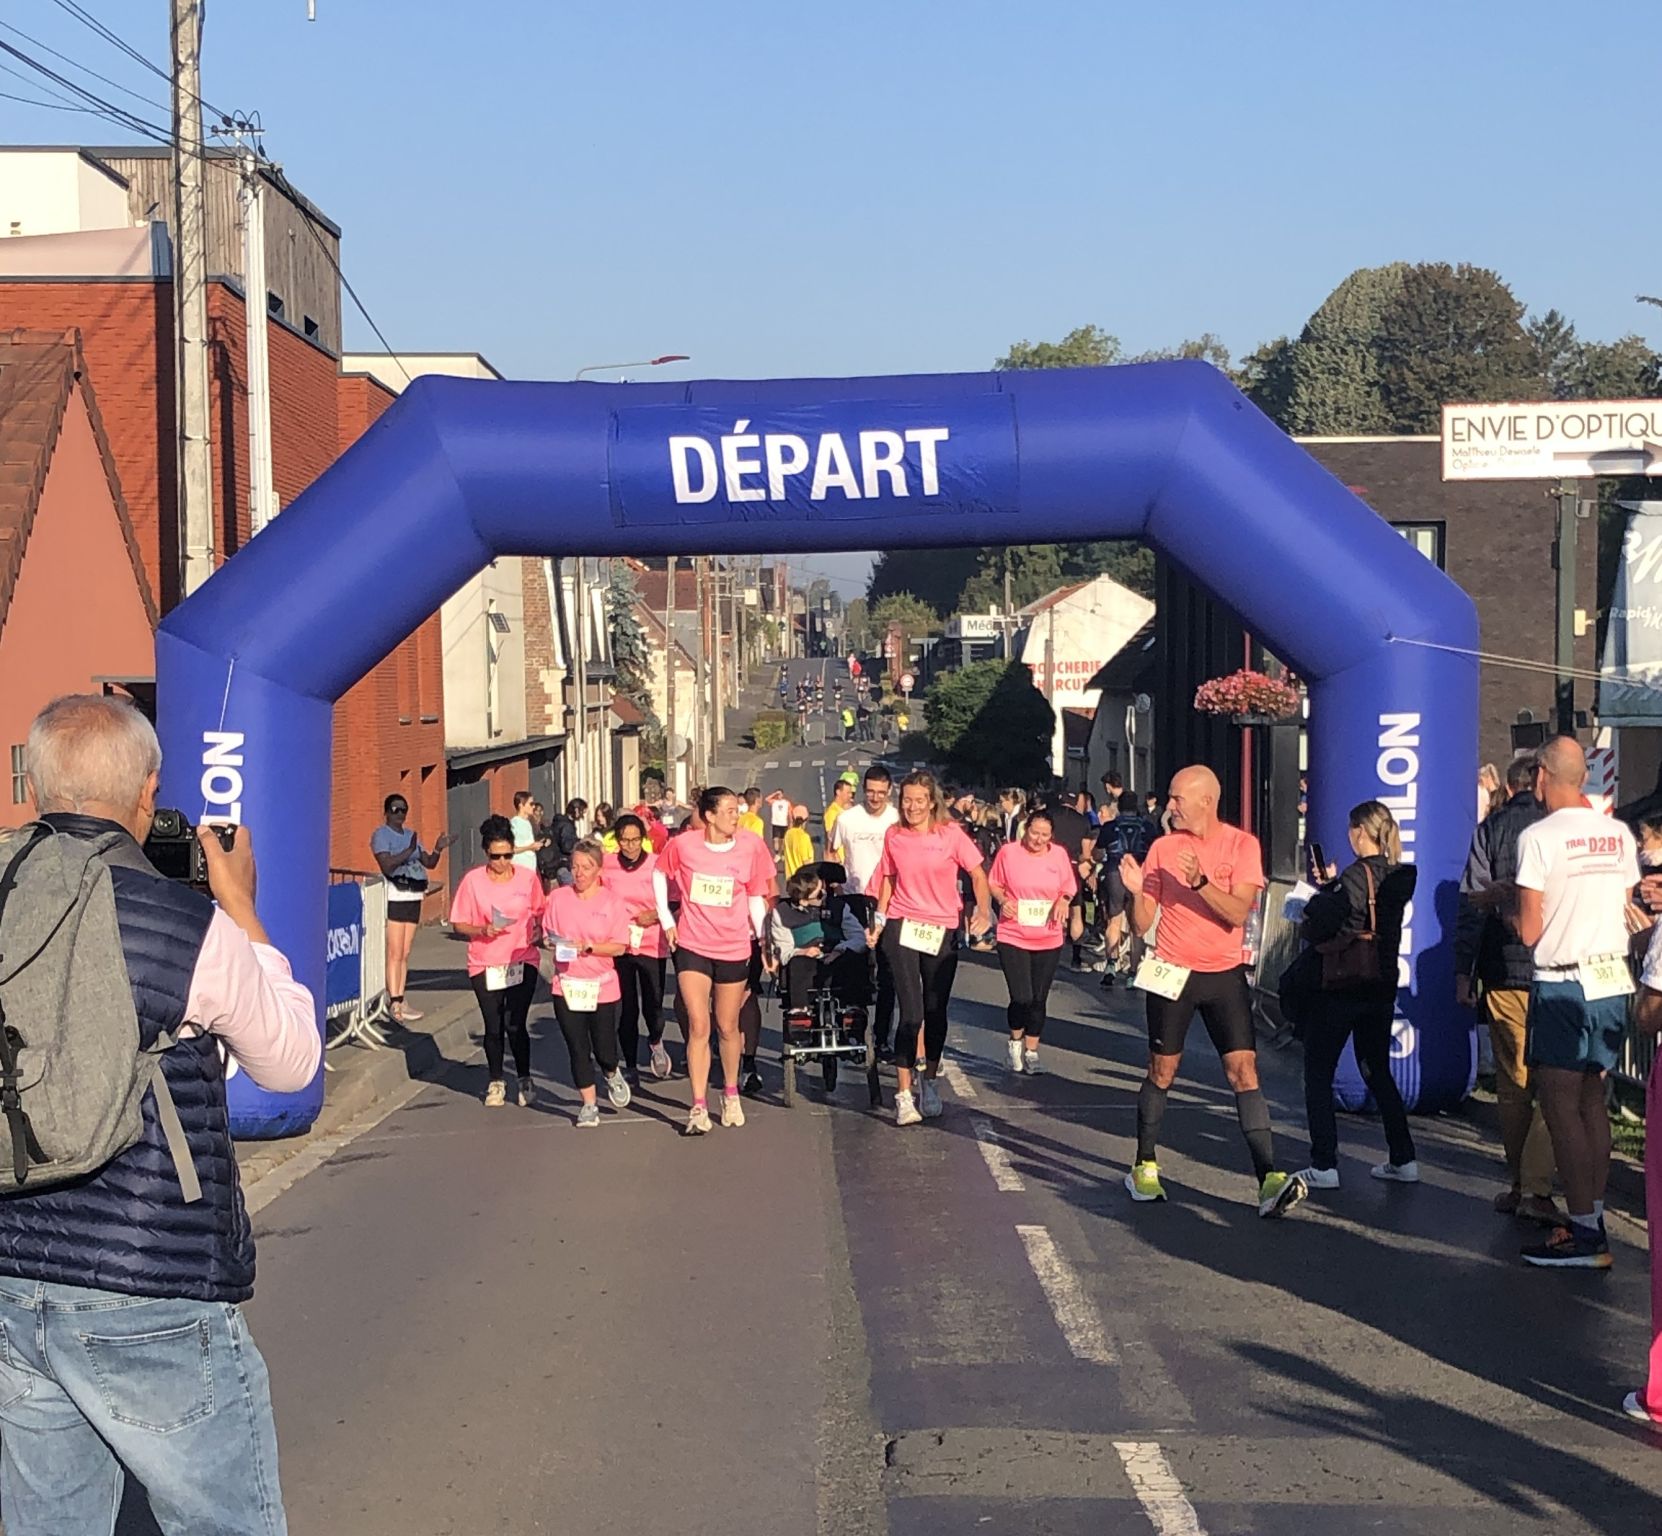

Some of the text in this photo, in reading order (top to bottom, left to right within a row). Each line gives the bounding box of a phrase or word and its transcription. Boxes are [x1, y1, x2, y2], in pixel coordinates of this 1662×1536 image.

[1452, 416, 1527, 442] ENVIE
[668, 420, 949, 504] DÉPART
[1588, 836, 1617, 852] D2B
[702, 883, 722, 895] 192
[913, 927, 933, 941] 185
[1154, 965, 1171, 980] 97
